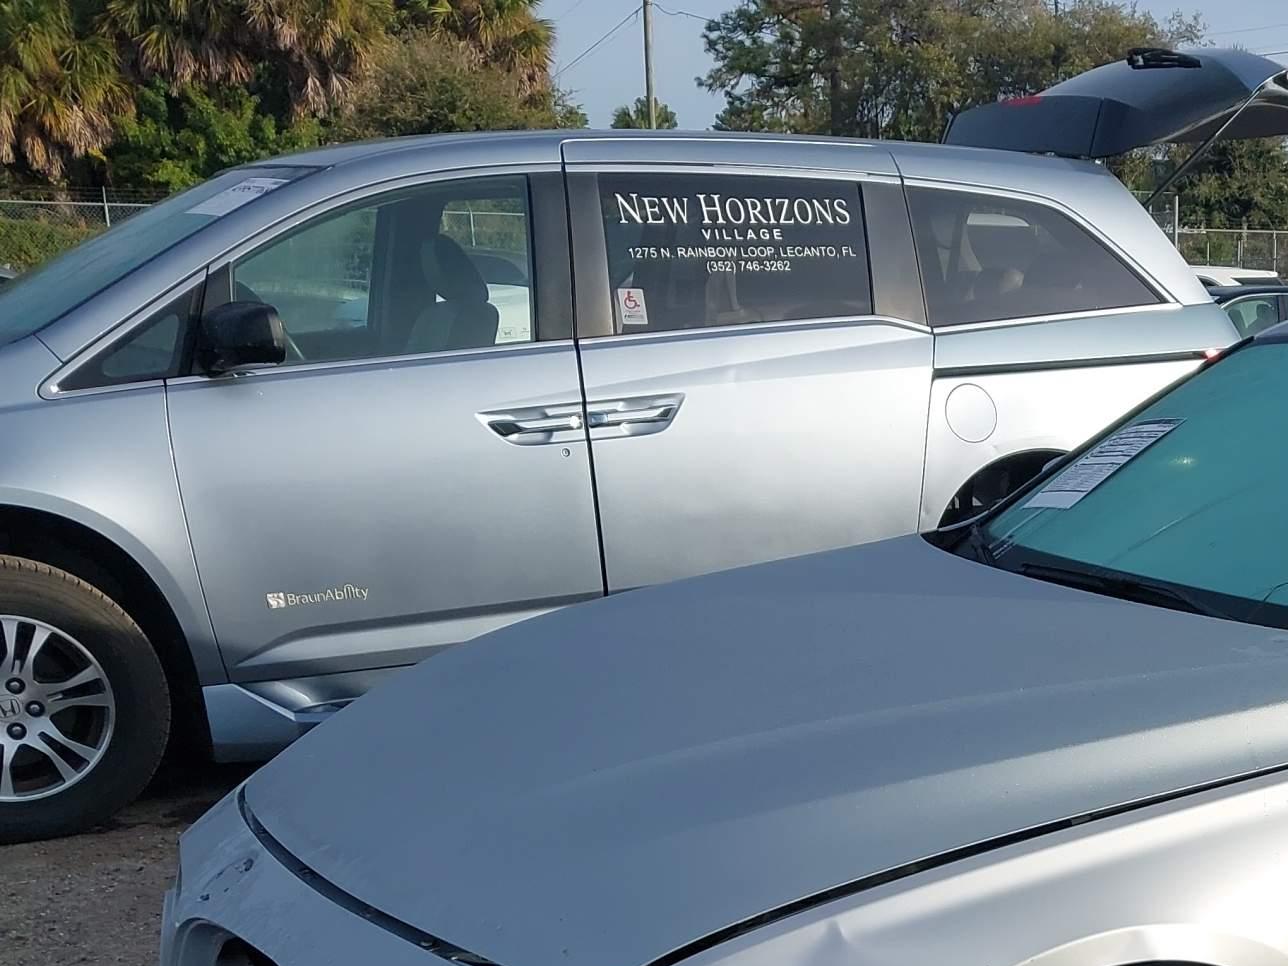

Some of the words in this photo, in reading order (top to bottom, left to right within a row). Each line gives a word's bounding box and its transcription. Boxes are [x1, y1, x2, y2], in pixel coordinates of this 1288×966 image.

[614, 193, 689, 224] NEW
[696, 193, 851, 225] HORIZONS
[701, 228, 784, 241] VILLAGE
[628, 247, 657, 259] 1275
[660, 247, 675, 259] N.
[677, 246, 738, 259] RAINBOW
[740, 246, 778, 260] LOOP,
[780, 246, 840, 260] LECANTO,
[842, 246, 856, 258] FL
[706, 260, 737, 275] (352)
[738, 260, 791, 273] 746-3262
[285, 583, 370, 606] BraunAbility
